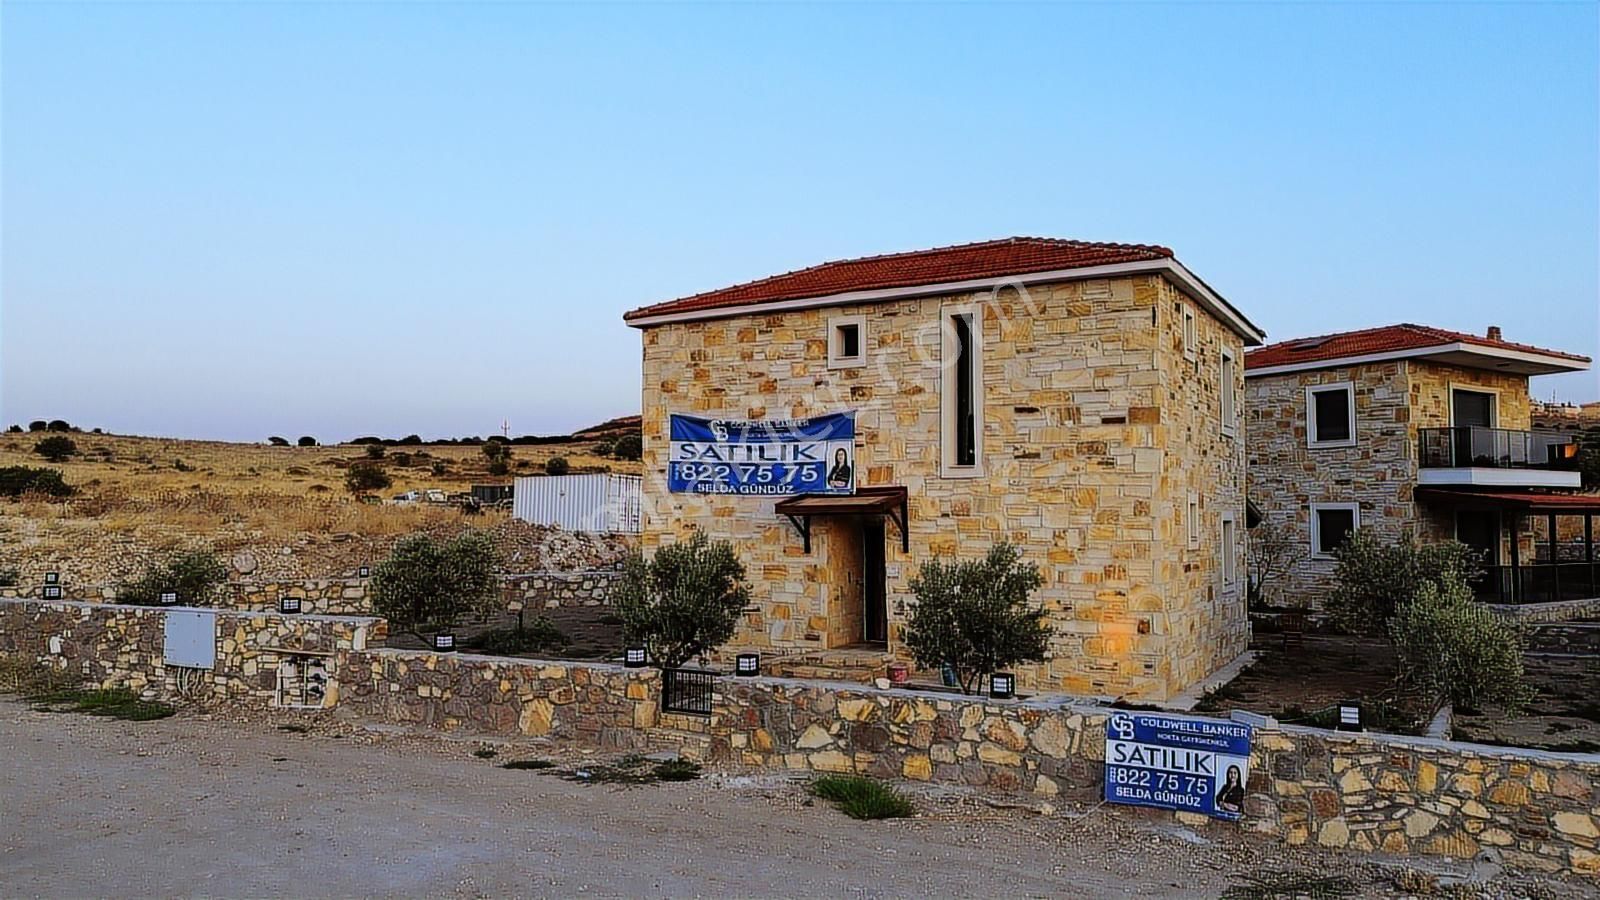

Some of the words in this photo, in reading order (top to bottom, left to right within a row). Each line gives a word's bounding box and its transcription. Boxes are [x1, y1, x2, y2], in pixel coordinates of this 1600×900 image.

[680, 443, 818, 462] SATILIK
[682, 464, 730, 482] 822
[740, 465, 773, 483] 75
[783, 465, 818, 483] 75
[697, 483, 737, 494] SELDA
[740, 482, 795, 495] GÜNDÜZ
[1140, 717, 1200, 733] COLDWELL
[1202, 724, 1249, 738] BANKER
[1114, 743, 1213, 774] SATILIK
[1117, 768, 1150, 787] 822
[1156, 772, 1179, 791] 75
[1185, 776, 1208, 795] 75
[1115, 786, 1152, 800] SELDA
[1154, 790, 1201, 808] GÜNDÜZ
